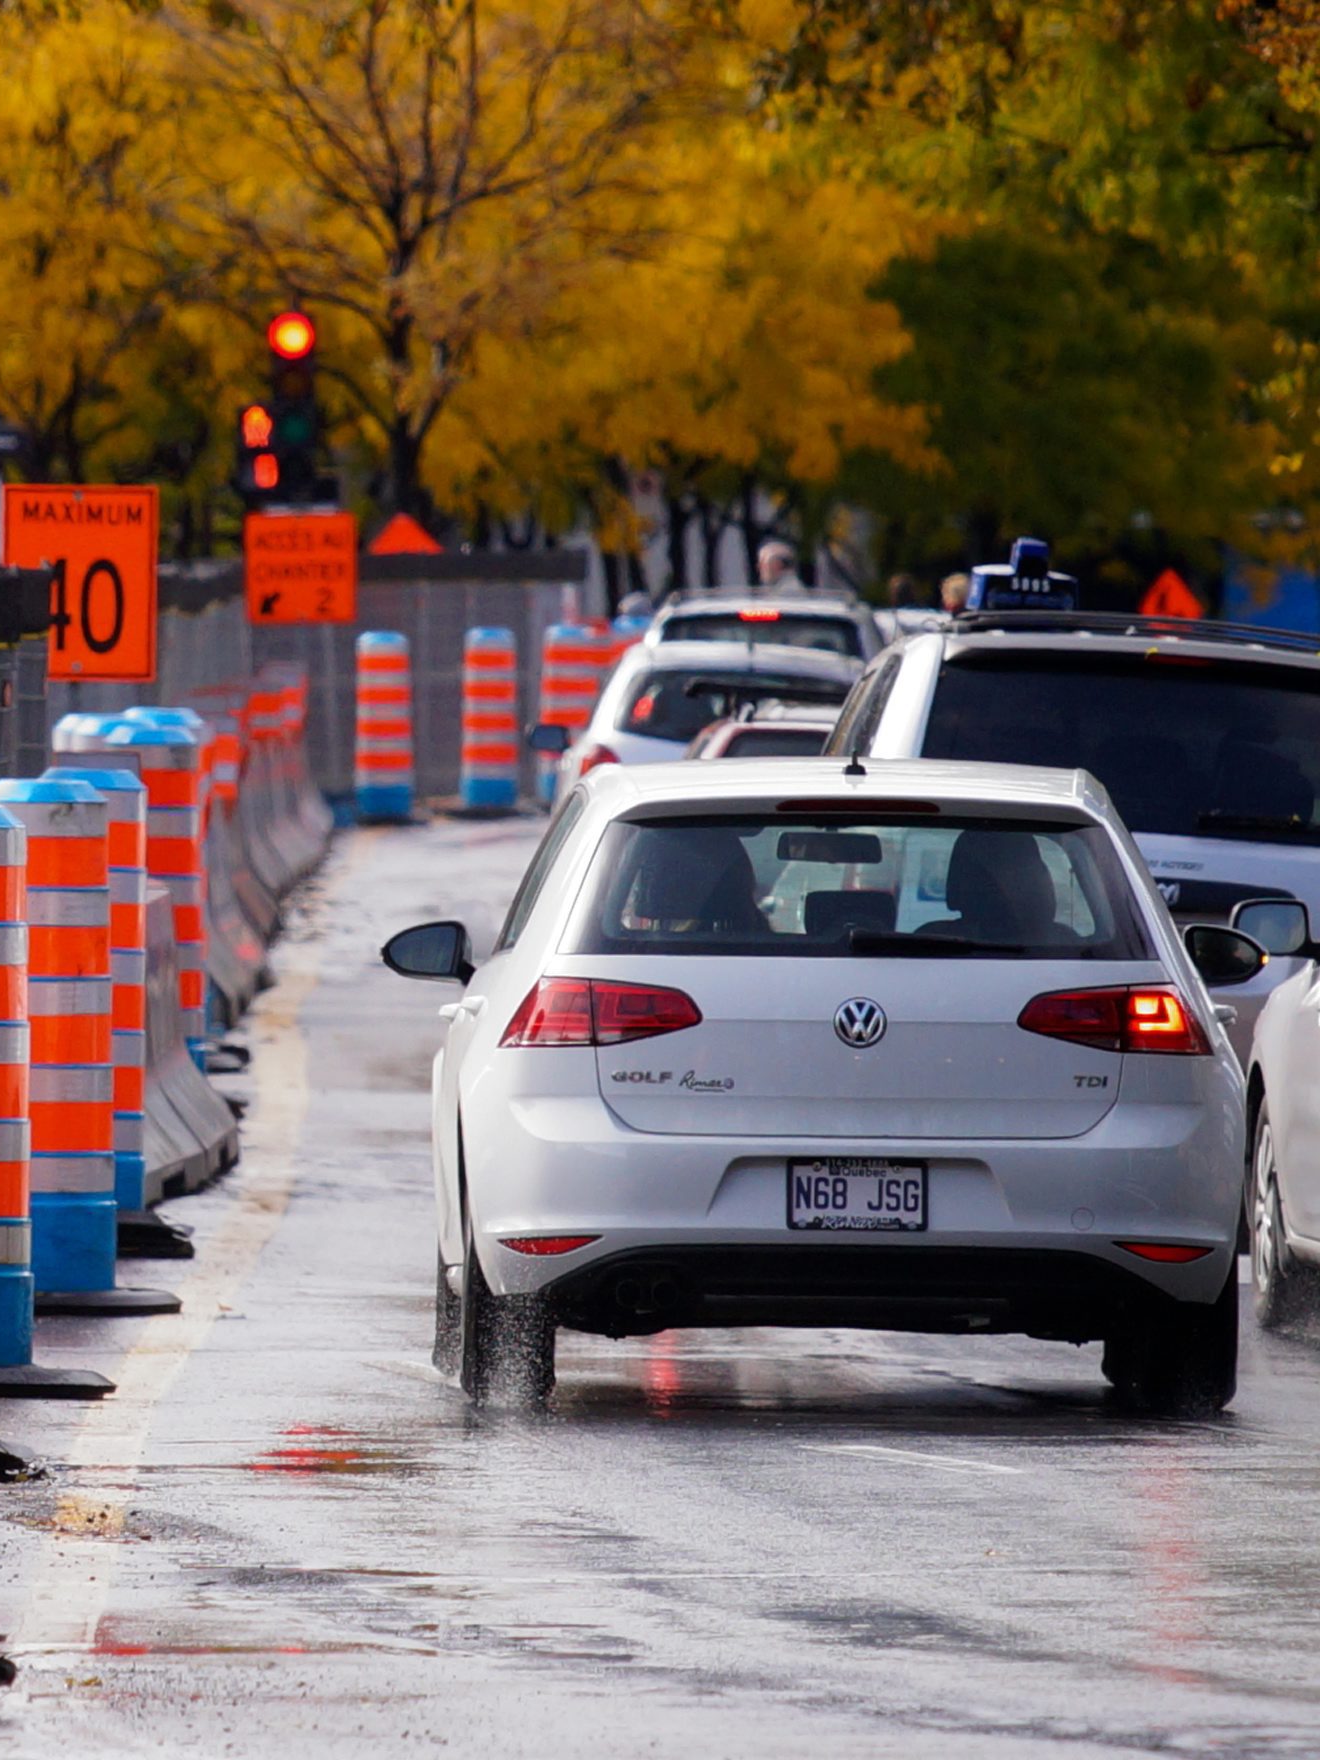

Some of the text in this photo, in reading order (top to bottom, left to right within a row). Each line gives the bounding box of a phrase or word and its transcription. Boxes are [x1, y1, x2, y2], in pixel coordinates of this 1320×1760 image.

[23, 502, 142, 526] MAXIMUM
[1073, 1075, 1109, 1088] TDI
[795, 1175, 920, 1212] N68 JSG
